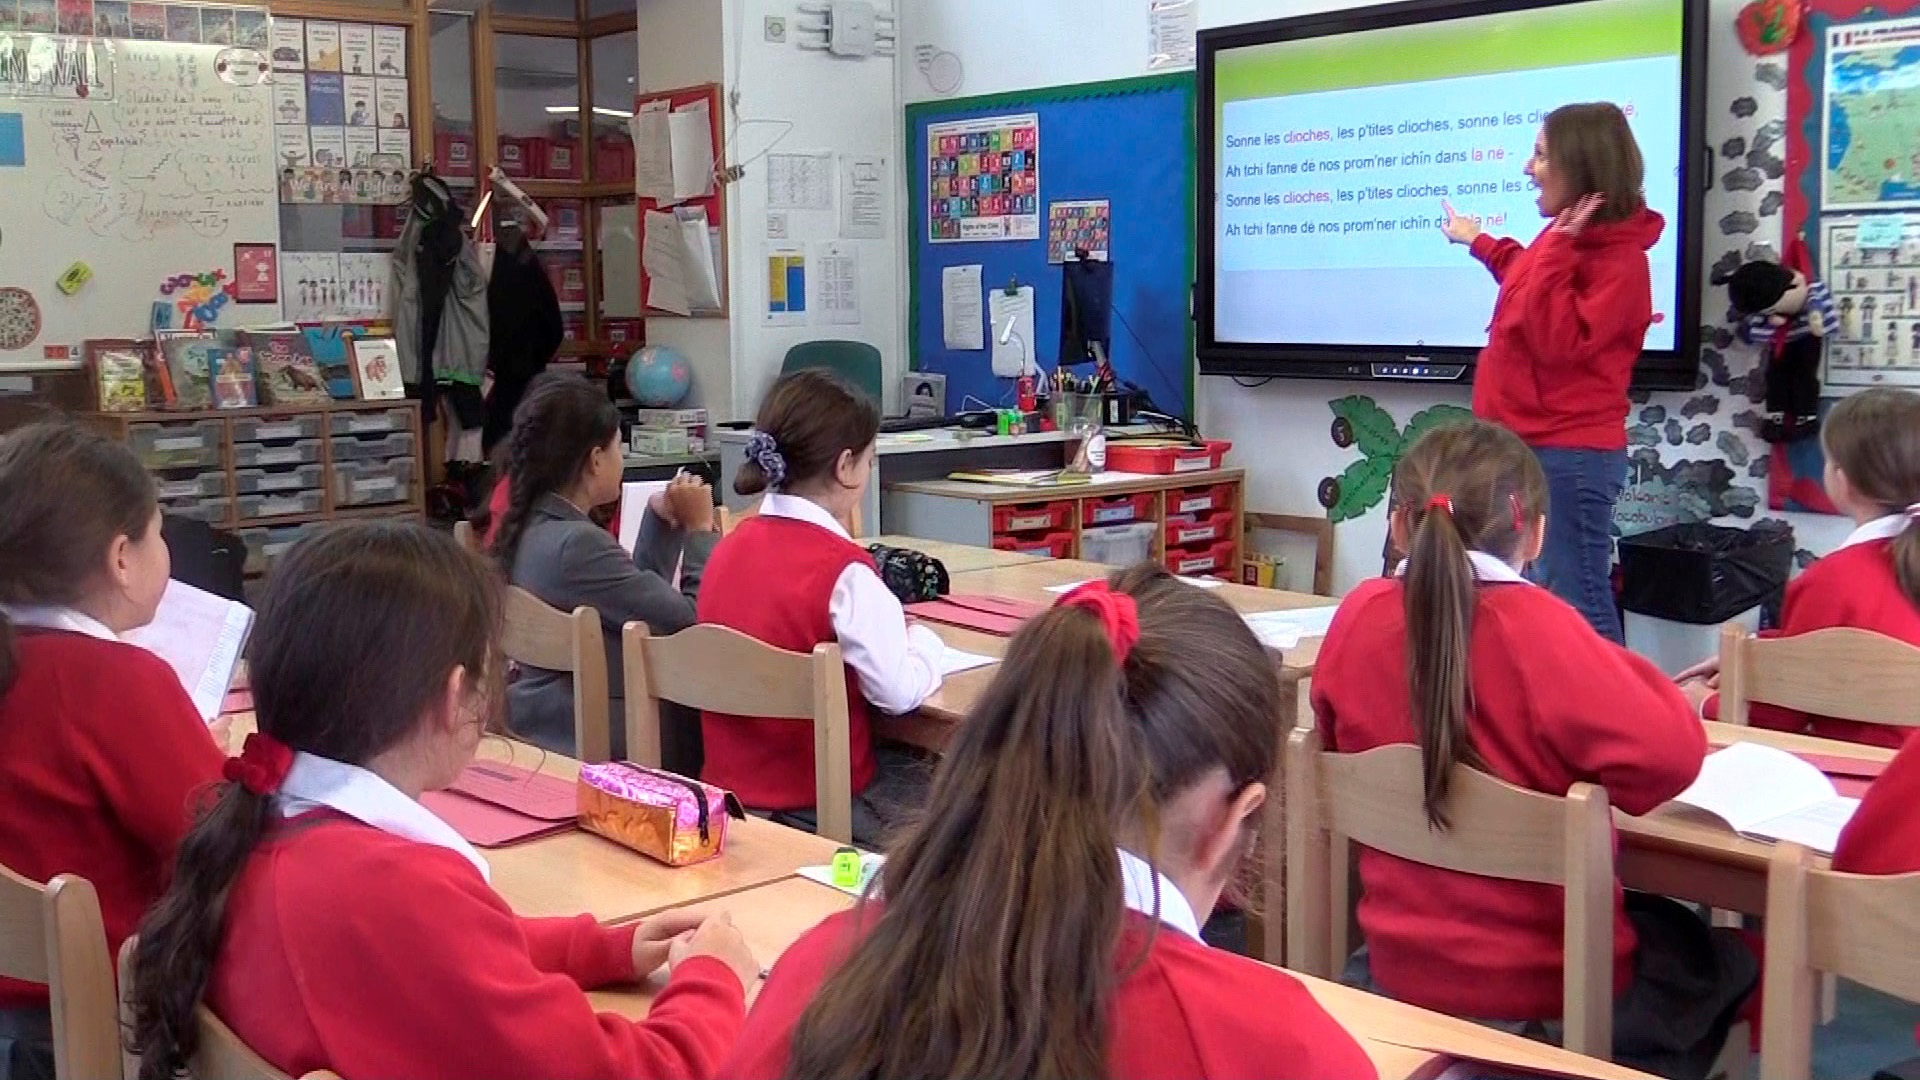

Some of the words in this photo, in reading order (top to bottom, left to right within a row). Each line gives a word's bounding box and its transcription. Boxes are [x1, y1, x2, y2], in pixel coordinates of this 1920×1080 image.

[1226, 134, 1261, 148] Sonne
[1264, 132, 1281, 145] les
[1284, 129, 1333, 144] clioches,
[1337, 126, 1355, 139] les
[1358, 123, 1393, 141] p'tites
[1398, 118, 1453, 134] clioches,
[1457, 114, 1499, 130] sonne
[1503, 110, 1523, 125] les
[1225, 164, 1241, 178] Ah
[1244, 163, 1264, 176] tchi
[1266, 162, 1298, 176] fanne
[1319, 160, 1341, 172] nos
[1344, 154, 1398, 172] prom'ner
[1435, 149, 1467, 164] dans
[1471, 147, 1484, 162] la
[1226, 194, 1262, 208] Sonne
[1264, 192, 1281, 205] les
[1283, 190, 1333, 205] clioches,
[1336, 188, 1354, 202] les
[1357, 185, 1394, 203] p'tites
[1397, 181, 1452, 198] clioches,
[1456, 180, 1498, 196] sonne
[1502, 178, 1522, 193] les
[1225, 223, 1241, 237] Ah
[1244, 222, 1263, 236] tchi
[1266, 222, 1298, 235] fanne
[1318, 221, 1340, 233] nos
[1343, 217, 1398, 235] prom'ner
